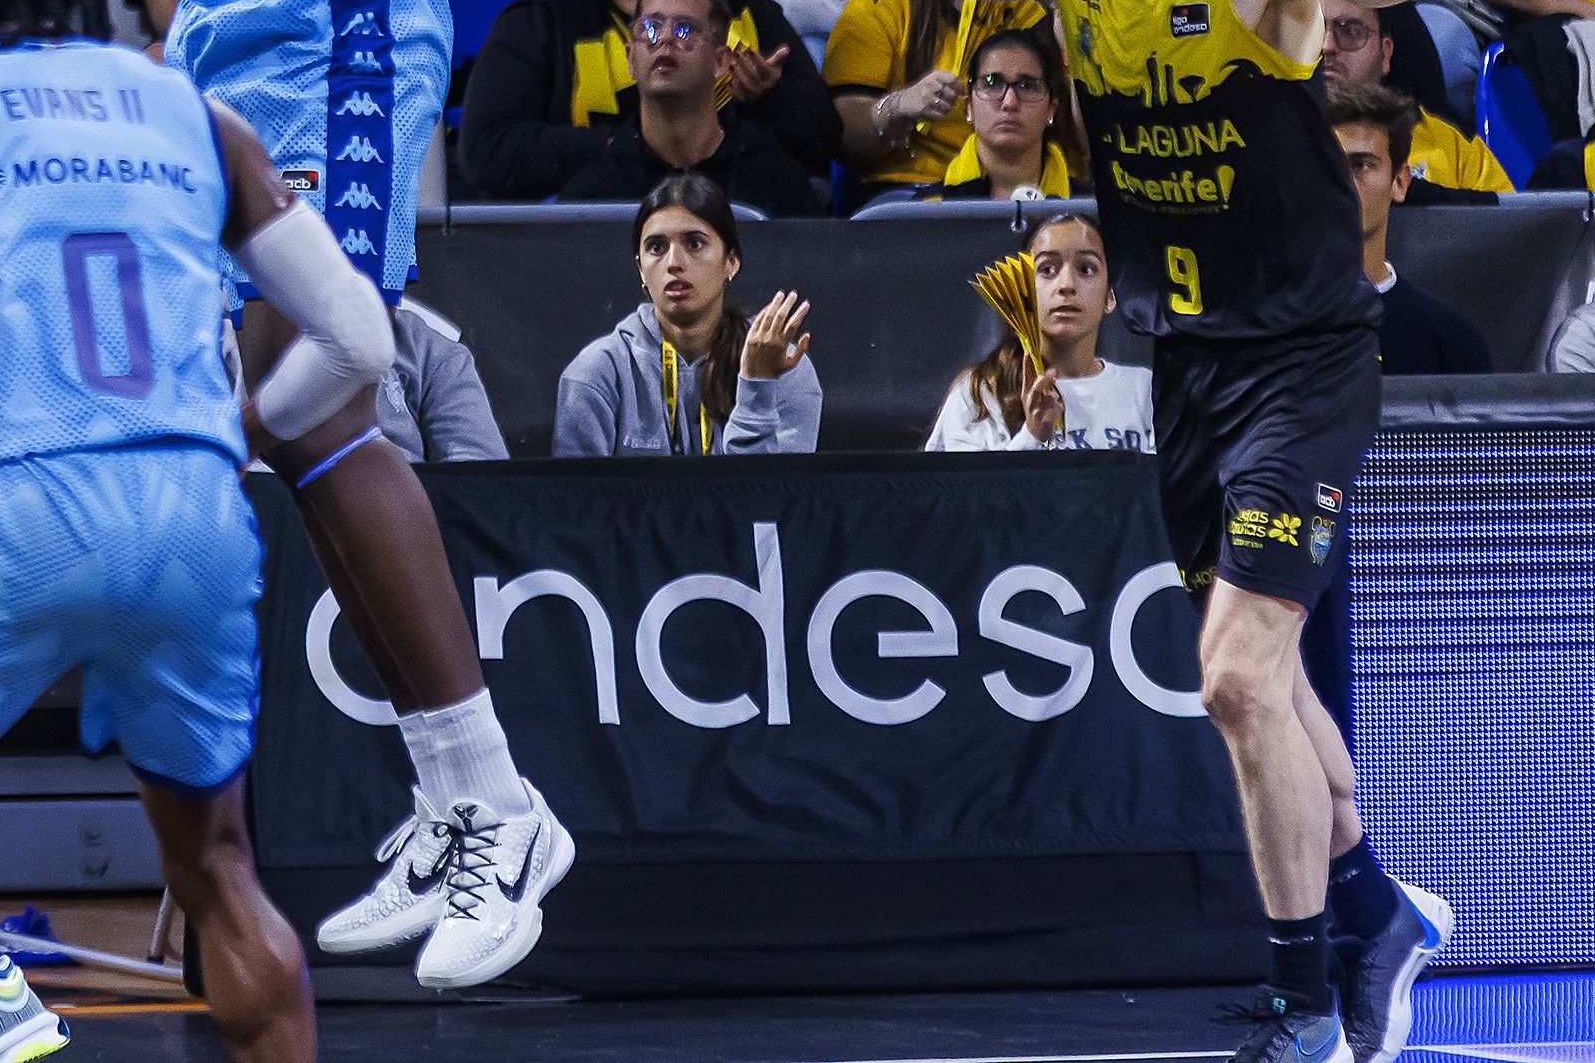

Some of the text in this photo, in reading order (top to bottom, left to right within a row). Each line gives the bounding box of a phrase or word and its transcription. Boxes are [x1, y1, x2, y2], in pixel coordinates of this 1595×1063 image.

[0, 87, 109, 123] EVANS
[1117, 118, 1246, 157] LAGUNA
[13, 157, 198, 193] MORABANC
[1165, 245, 1203, 315] 9
[61, 232, 155, 399] 0
